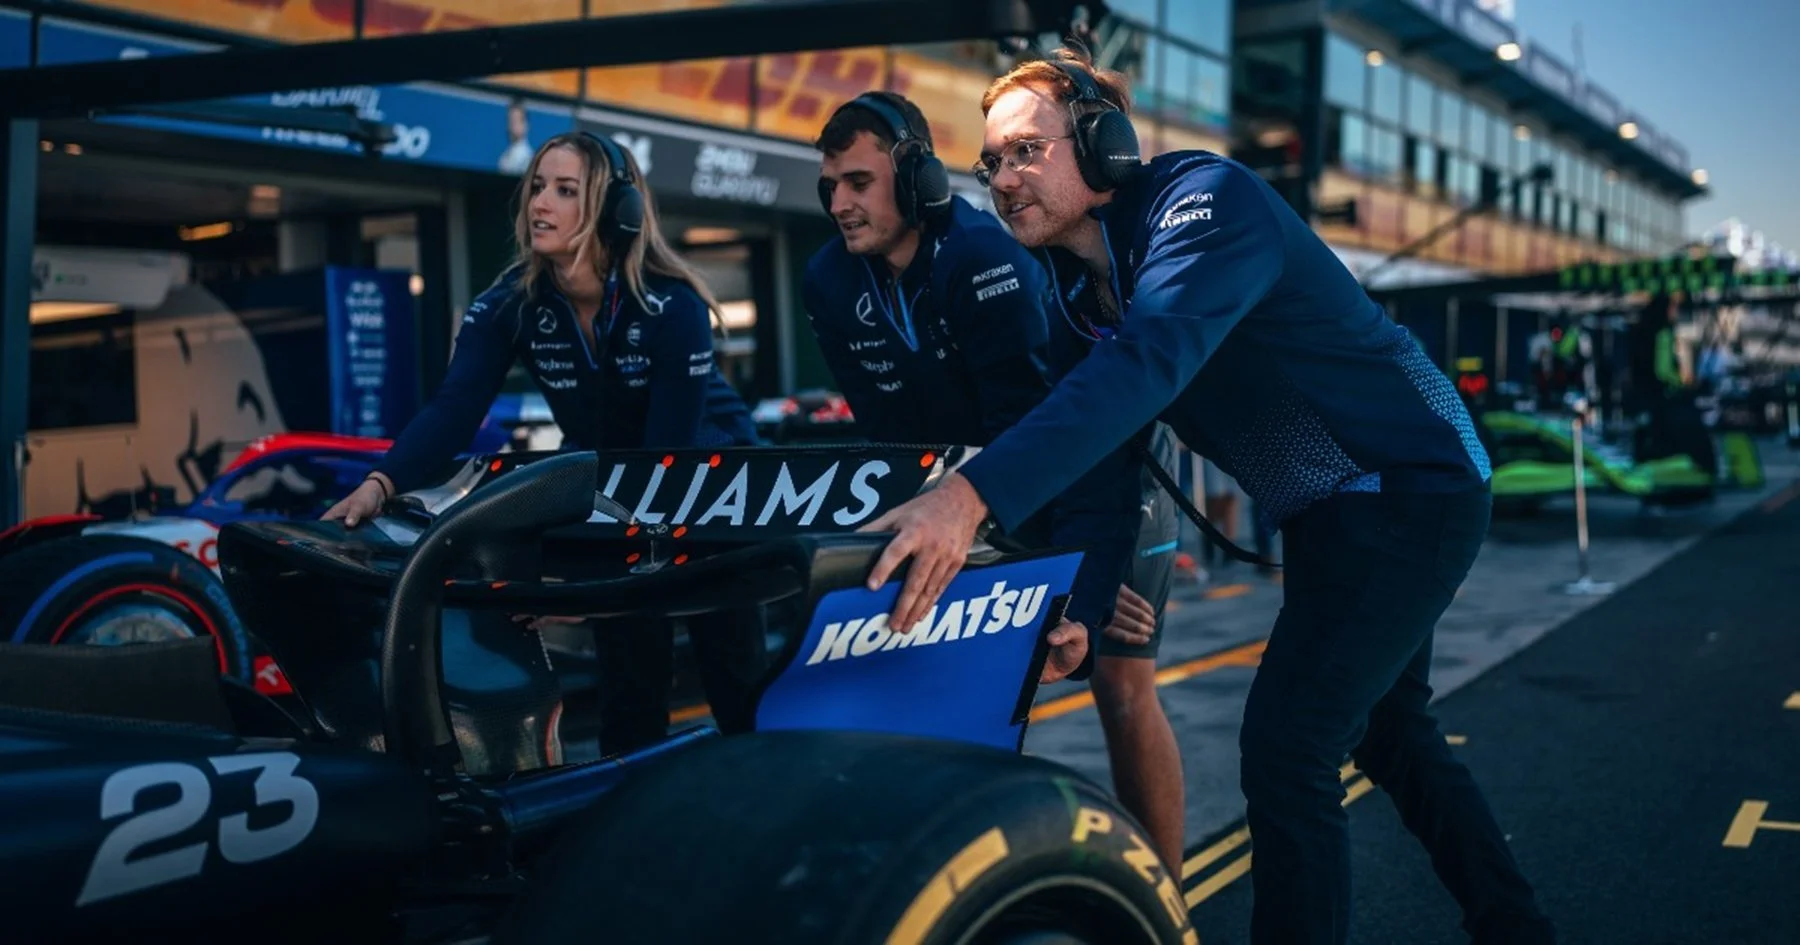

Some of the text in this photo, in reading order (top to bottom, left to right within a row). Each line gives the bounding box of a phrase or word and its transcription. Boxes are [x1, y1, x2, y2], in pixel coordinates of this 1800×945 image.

[586, 460, 891, 526] LLIAMS
[805, 580, 1049, 666] KOMATSU
[75, 752, 319, 908] 23
[1071, 807, 1199, 945] P ZE
